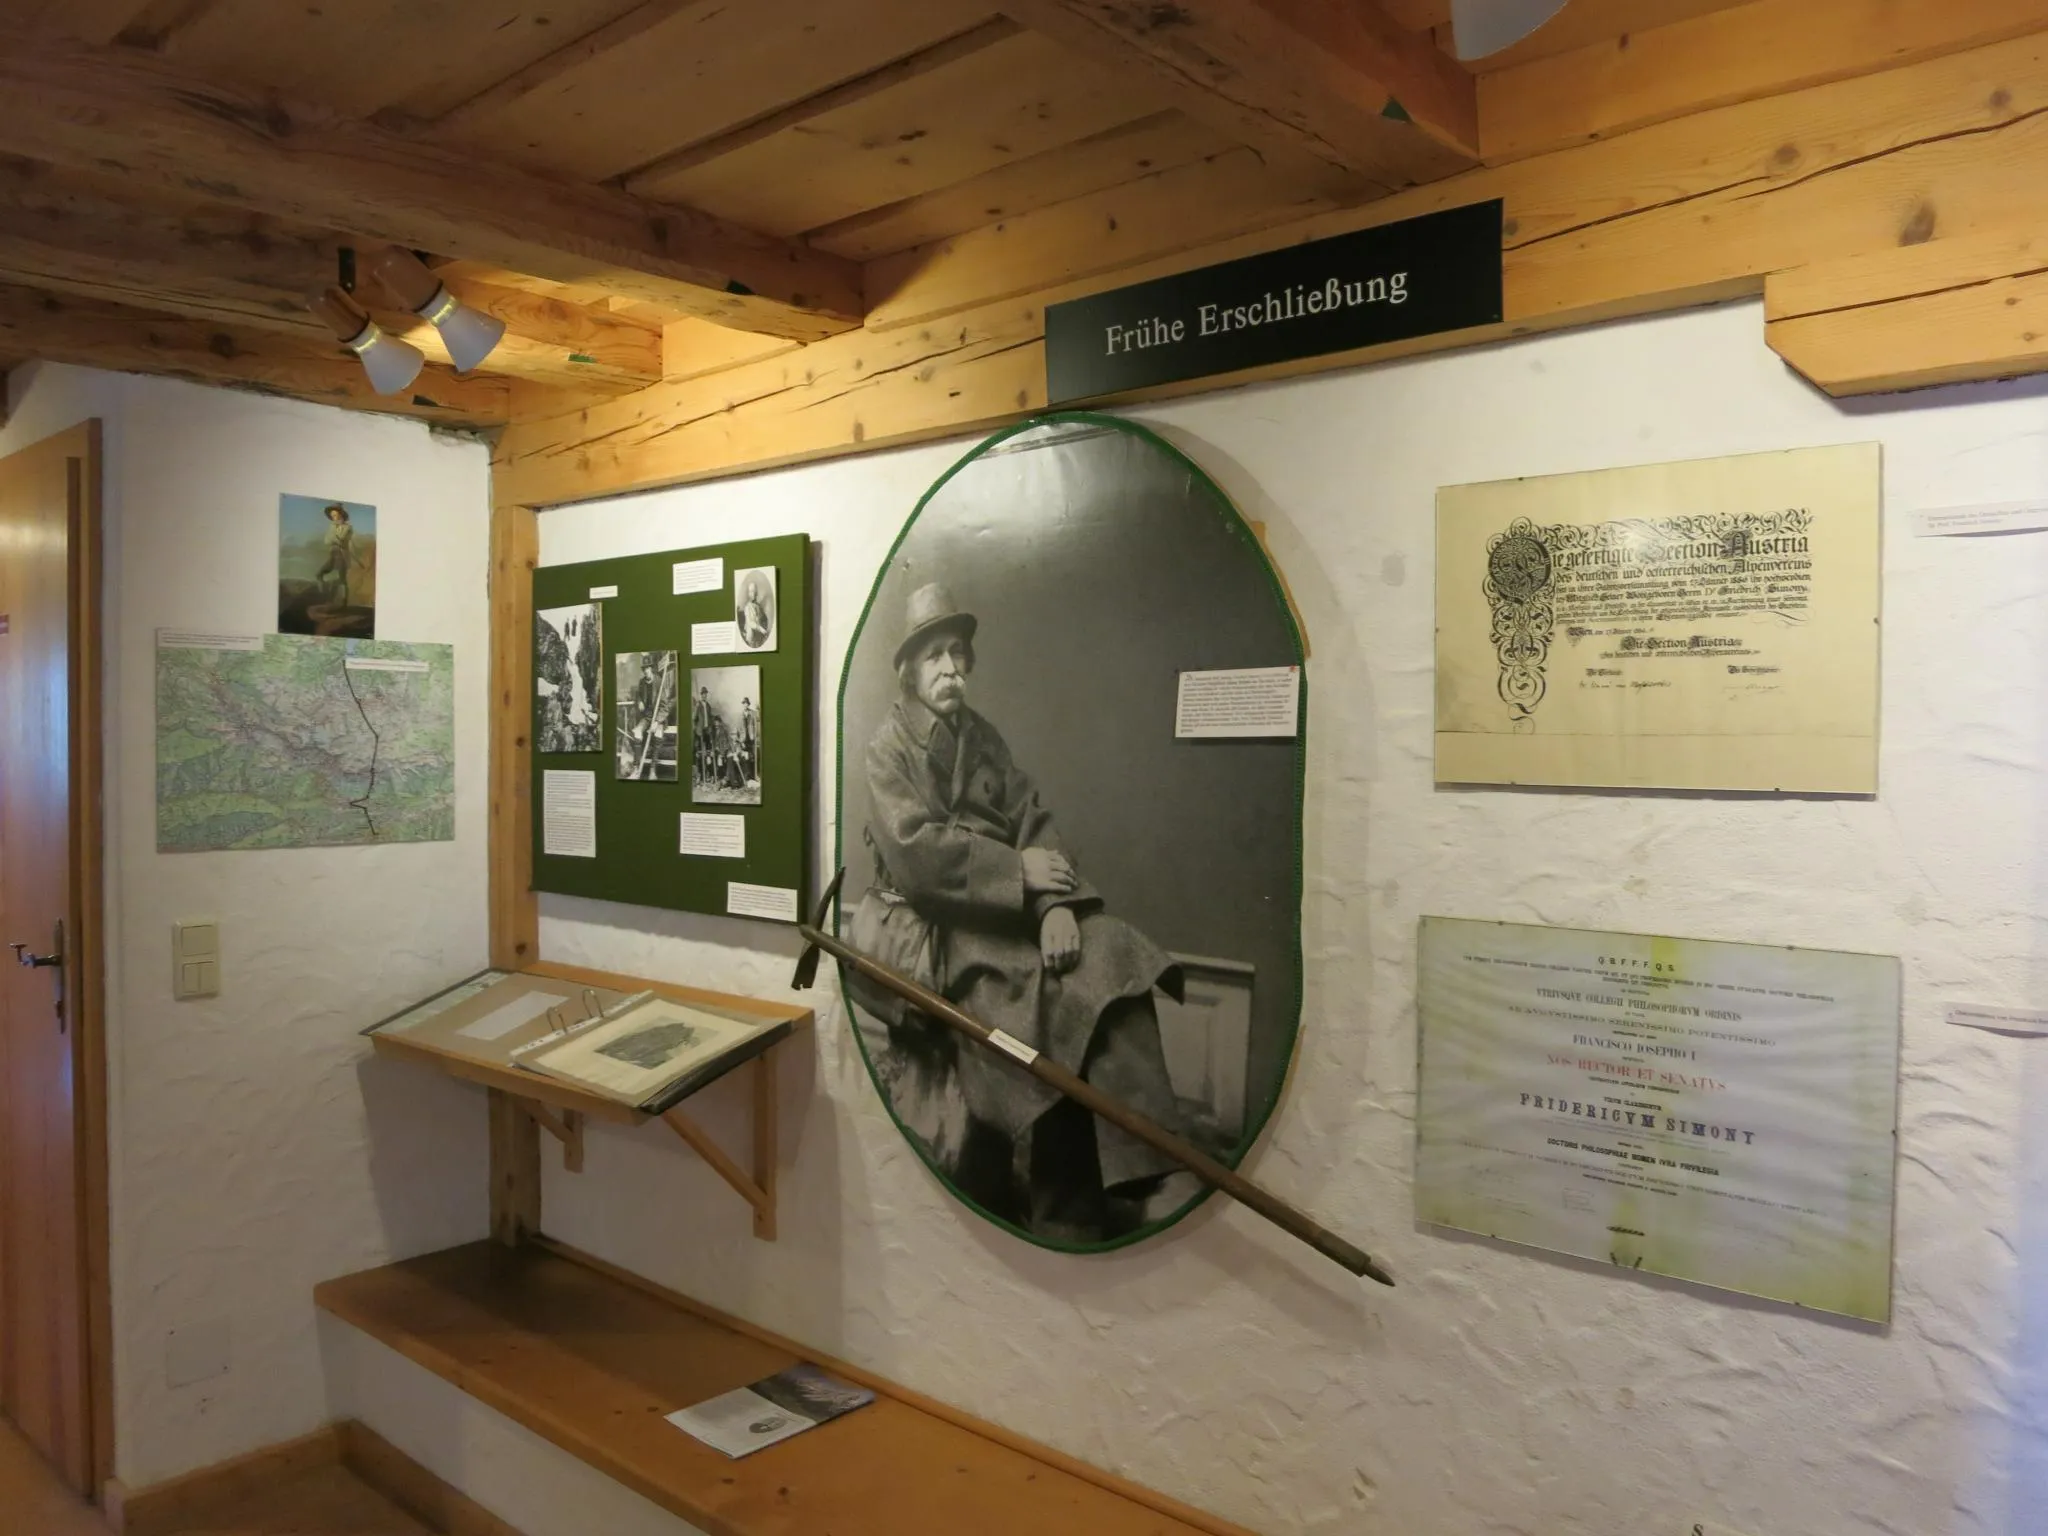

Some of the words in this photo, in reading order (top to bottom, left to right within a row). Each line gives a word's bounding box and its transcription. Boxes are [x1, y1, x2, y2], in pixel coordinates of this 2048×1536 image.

[1105, 317, 1185, 356] Frühe
[1198, 271, 1408, 337] Erschließung
[1720, 530, 1809, 559] Austria
[1637, 1067, 1655, 1081] ET
